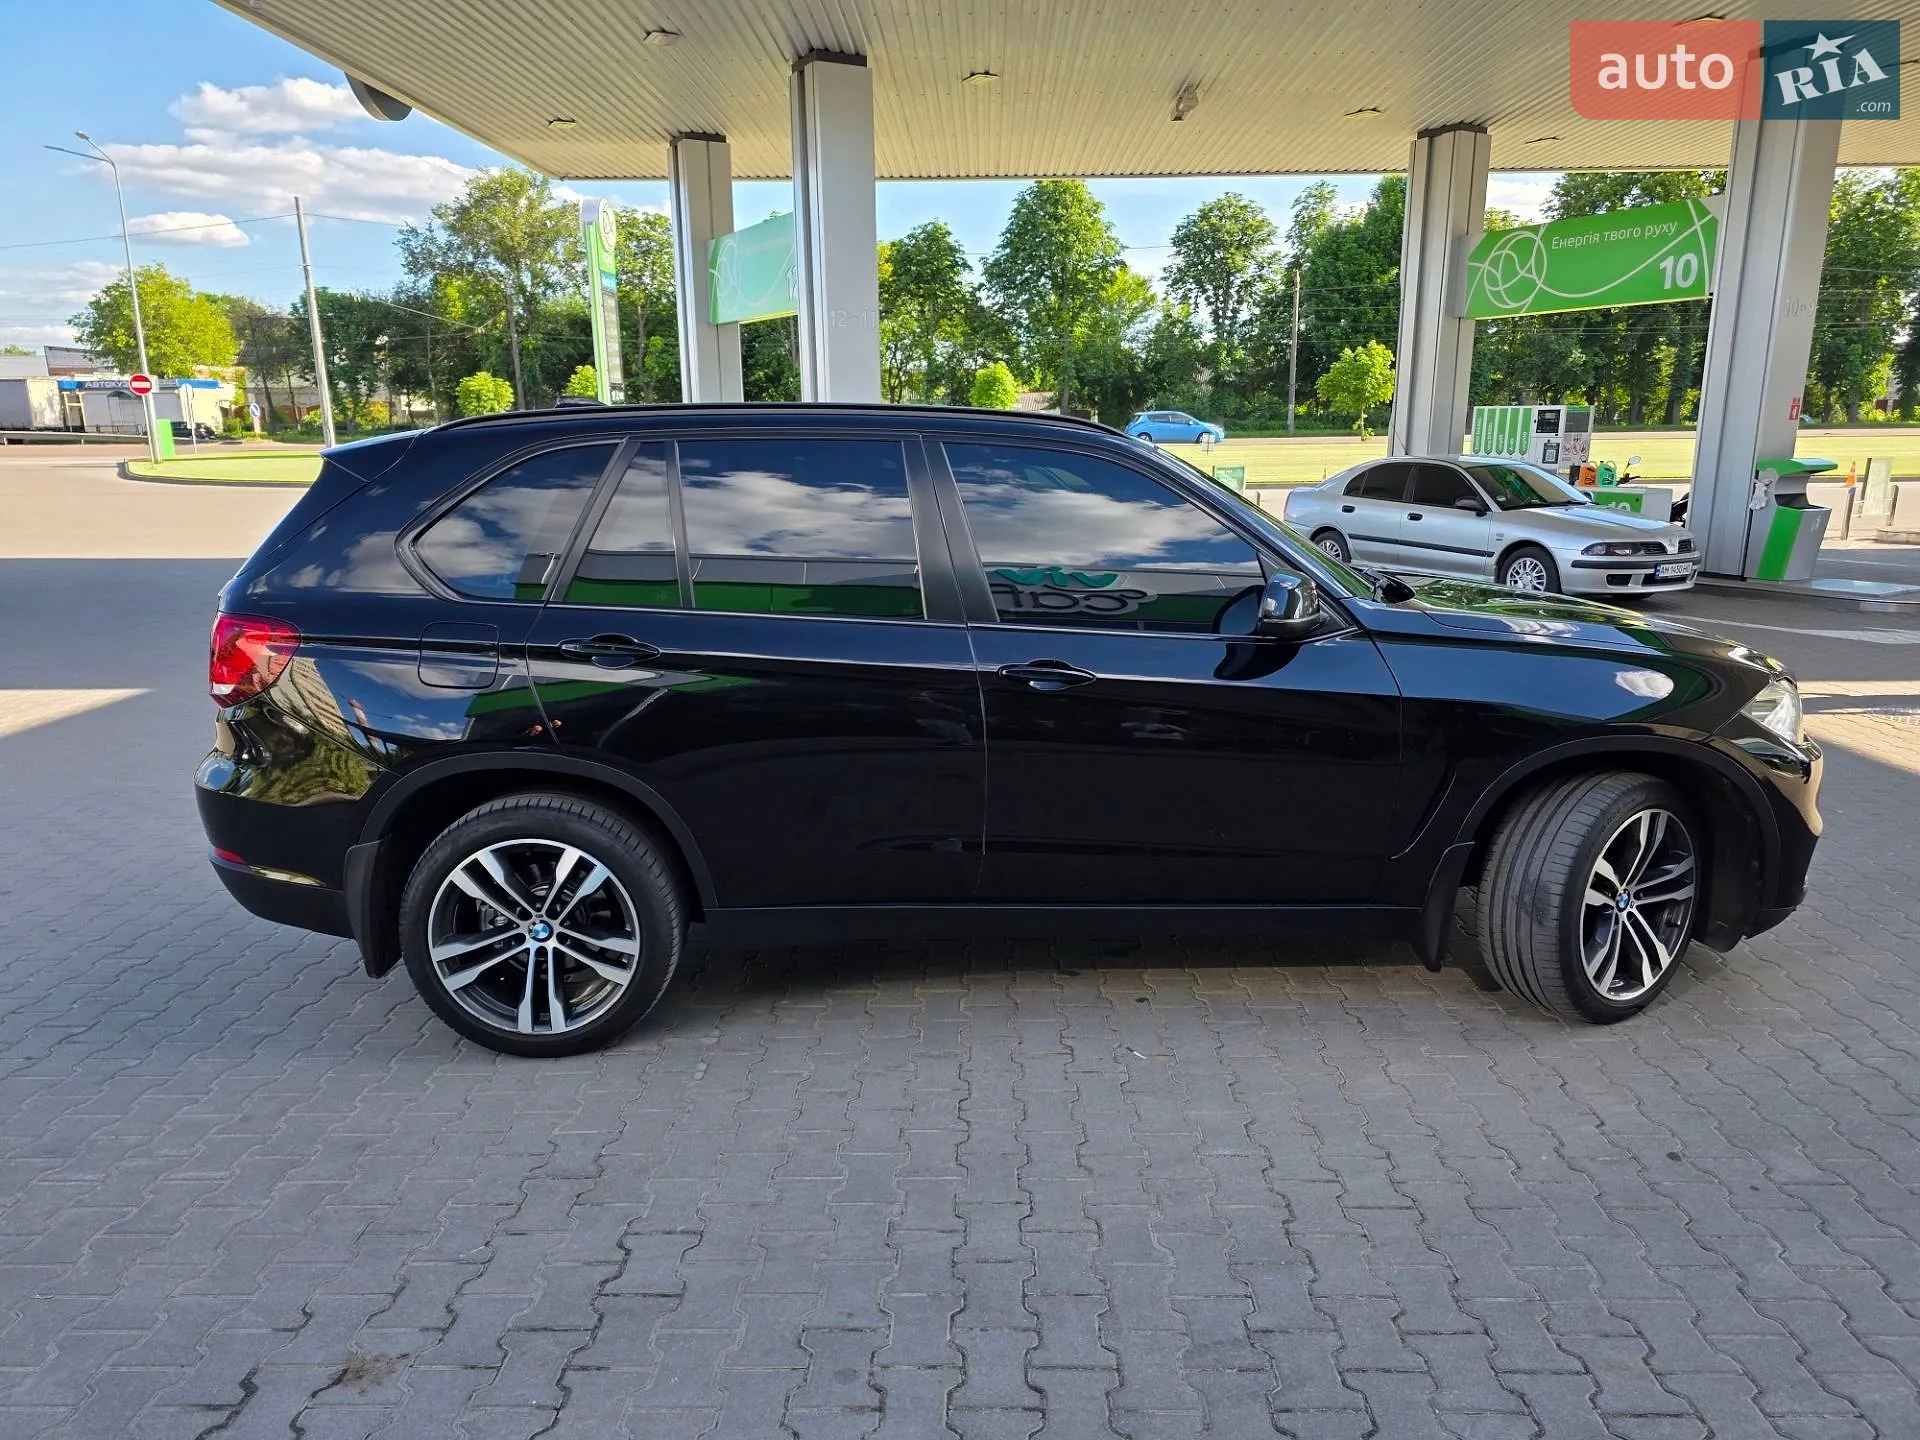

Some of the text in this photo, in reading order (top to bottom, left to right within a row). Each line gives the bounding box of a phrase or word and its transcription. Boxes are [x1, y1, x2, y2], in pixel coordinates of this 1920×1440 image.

[1551, 221, 1678, 250] Енергія твого руху
[1659, 252, 1699, 290] 10
[85, 381, 128, 389] АВТОКУЗ
